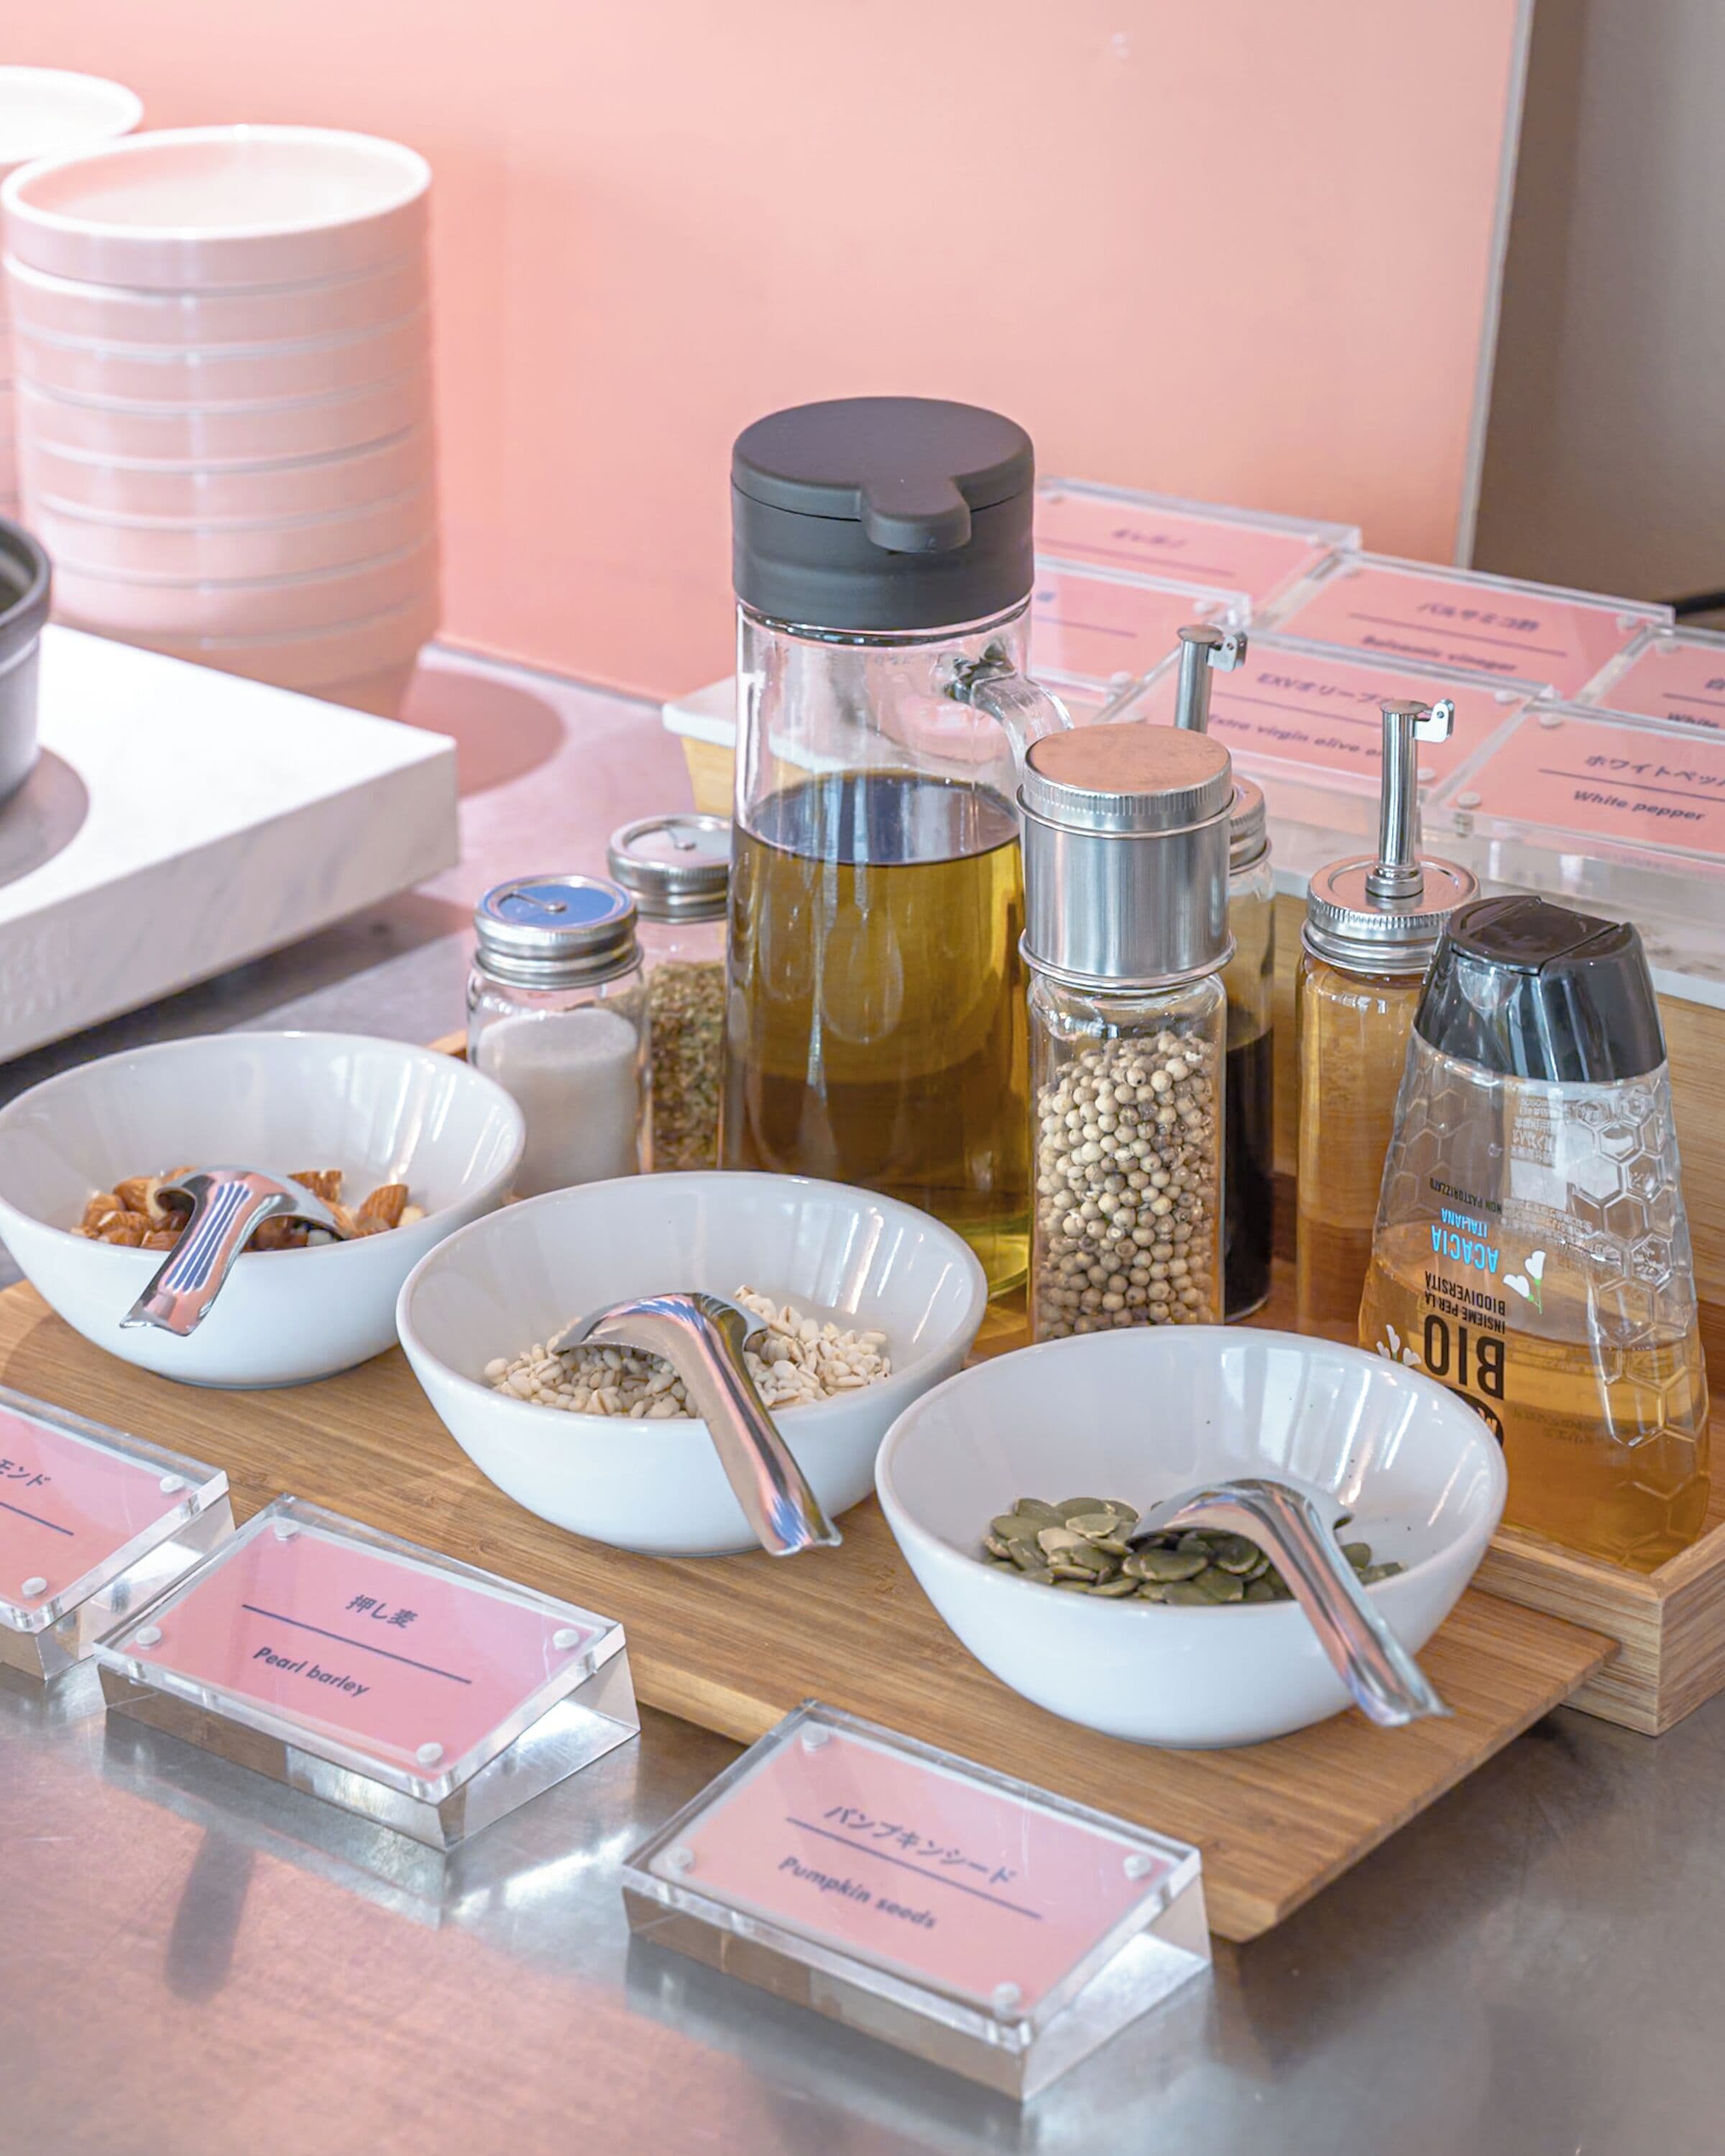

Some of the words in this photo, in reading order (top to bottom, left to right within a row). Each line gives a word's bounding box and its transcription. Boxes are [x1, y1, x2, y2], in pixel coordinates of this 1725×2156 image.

[1257, 725, 1309, 741] virgin
[1315, 737, 1361, 753] olive
[1573, 790, 1628, 808] White
[1632, 802, 1706, 821] pepper
[1429, 1177, 1484, 1208] PASTORIZZATO
[1485, 1199, 1503, 1215] NON
[1440, 1207, 1488, 1238] ITALIANA
[1430, 1224, 1499, 1273] ACACIA
[1425, 1271, 1506, 1316] BIODIVERSITÀ
[1425, 1289, 1437, 1308] LA
[1439, 1297, 1458, 1317] PER
[1463, 1307, 1506, 1335] INSIEME
[1424, 1314, 1505, 1401] BIO
[346, 1594, 418, 1628] 押し麦
[253, 1646, 308, 1673] Pearl
[305, 1664, 371, 1697] barley
[778, 1856, 871, 1904] Pumpkin
[875, 1898, 937, 1930] seeds
